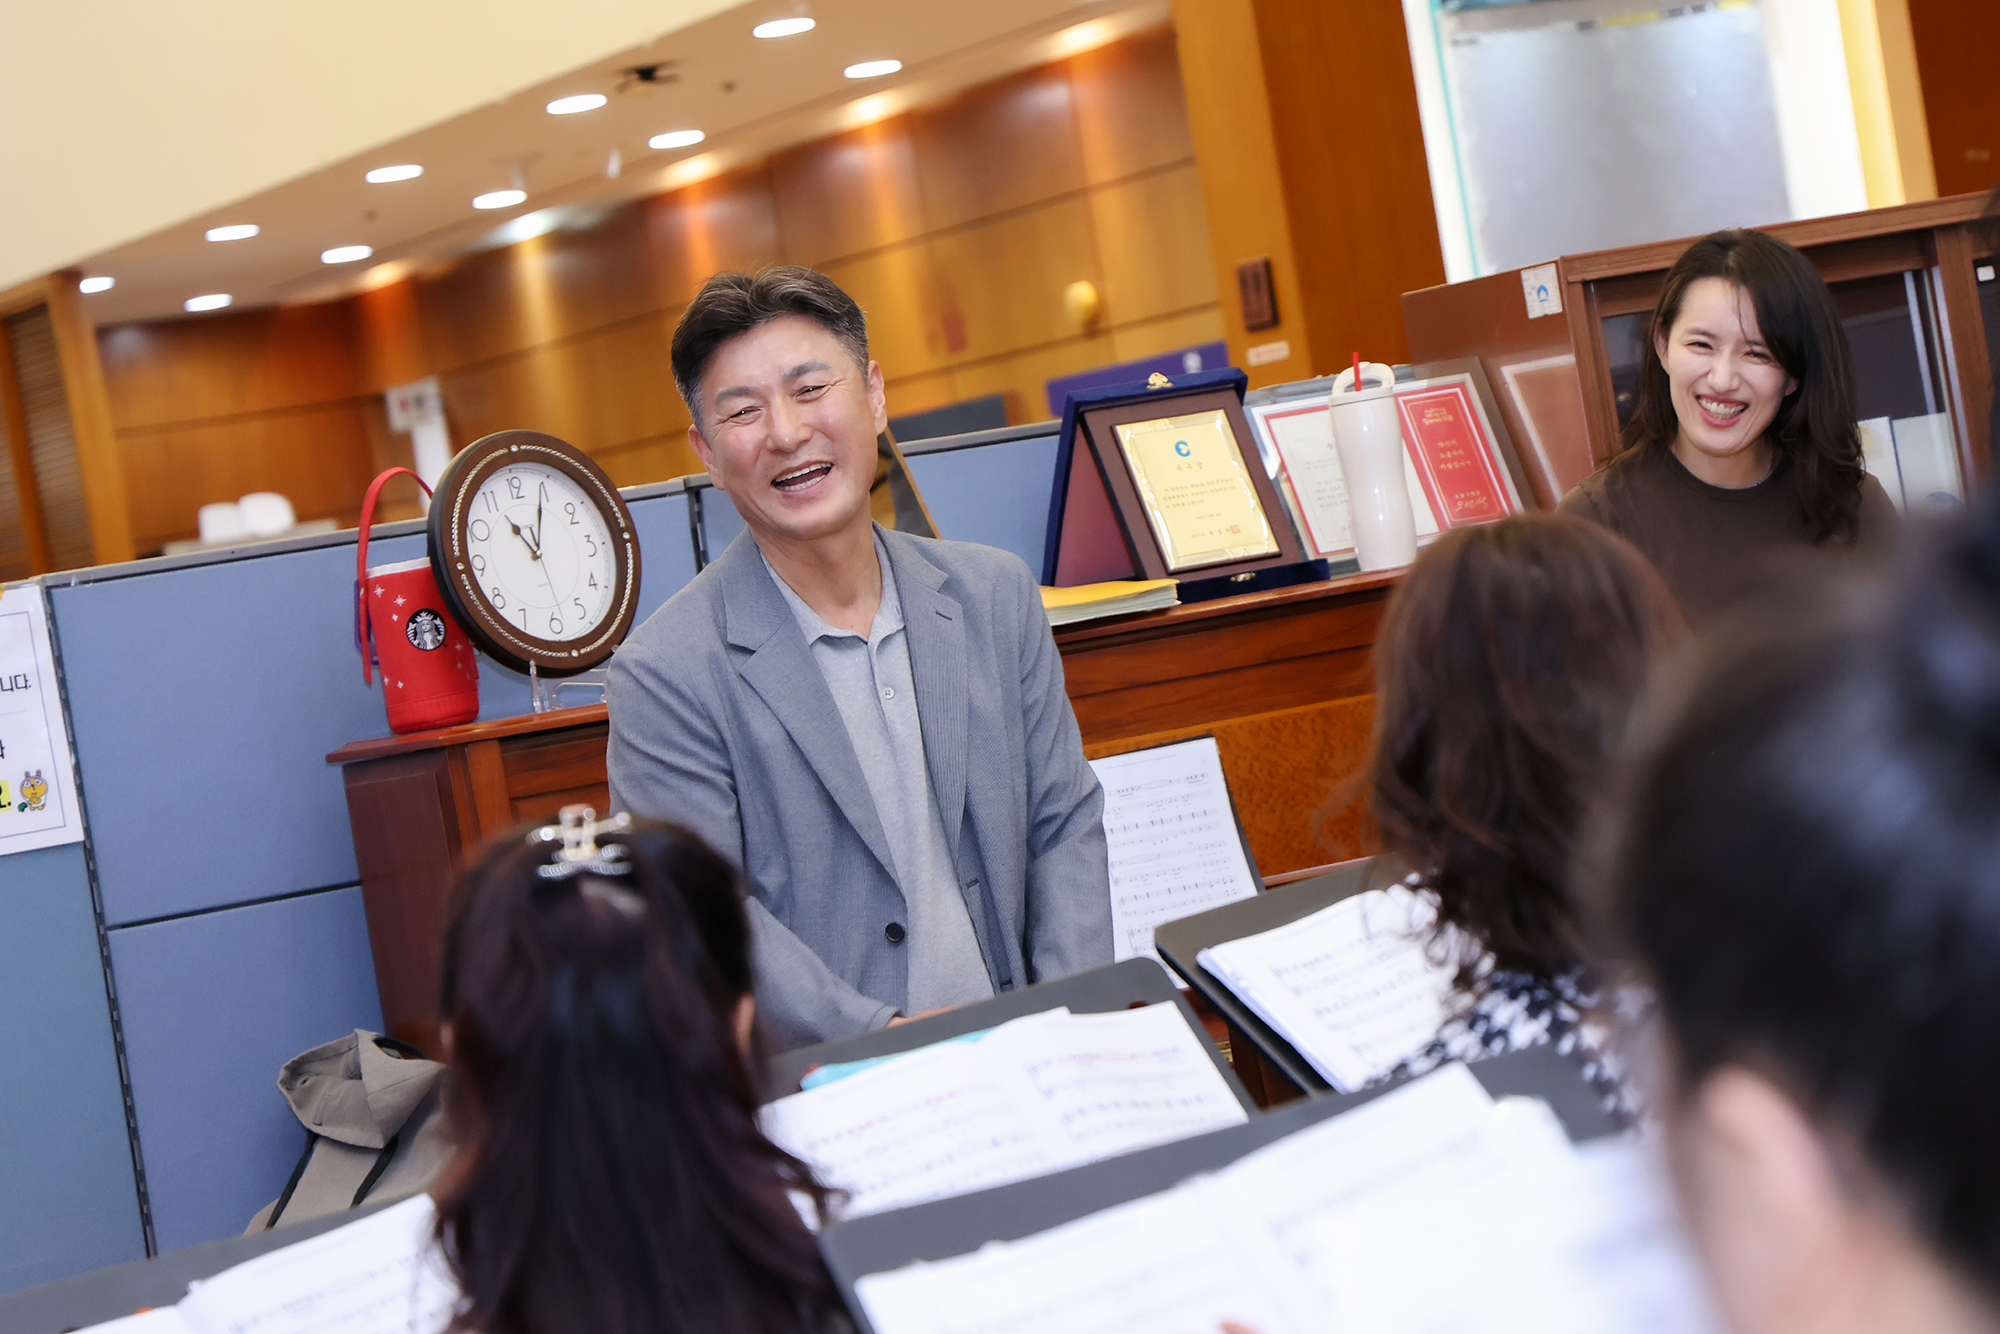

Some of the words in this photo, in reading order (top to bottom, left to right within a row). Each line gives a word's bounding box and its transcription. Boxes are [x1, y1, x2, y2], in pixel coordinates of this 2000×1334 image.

[505, 476, 525, 500] 12
[482, 490, 499, 513] 11
[564, 502, 580, 525] 2
[466, 519, 490, 544] 10
[584, 534, 597, 557] 3
[471, 554, 486, 577] 9
[588, 571, 598, 591] 4
[491, 587, 506, 610] 8
[573, 597, 586, 620] 5
[518, 608, 527, 631] 7
[549, 611, 563, 634] 6
